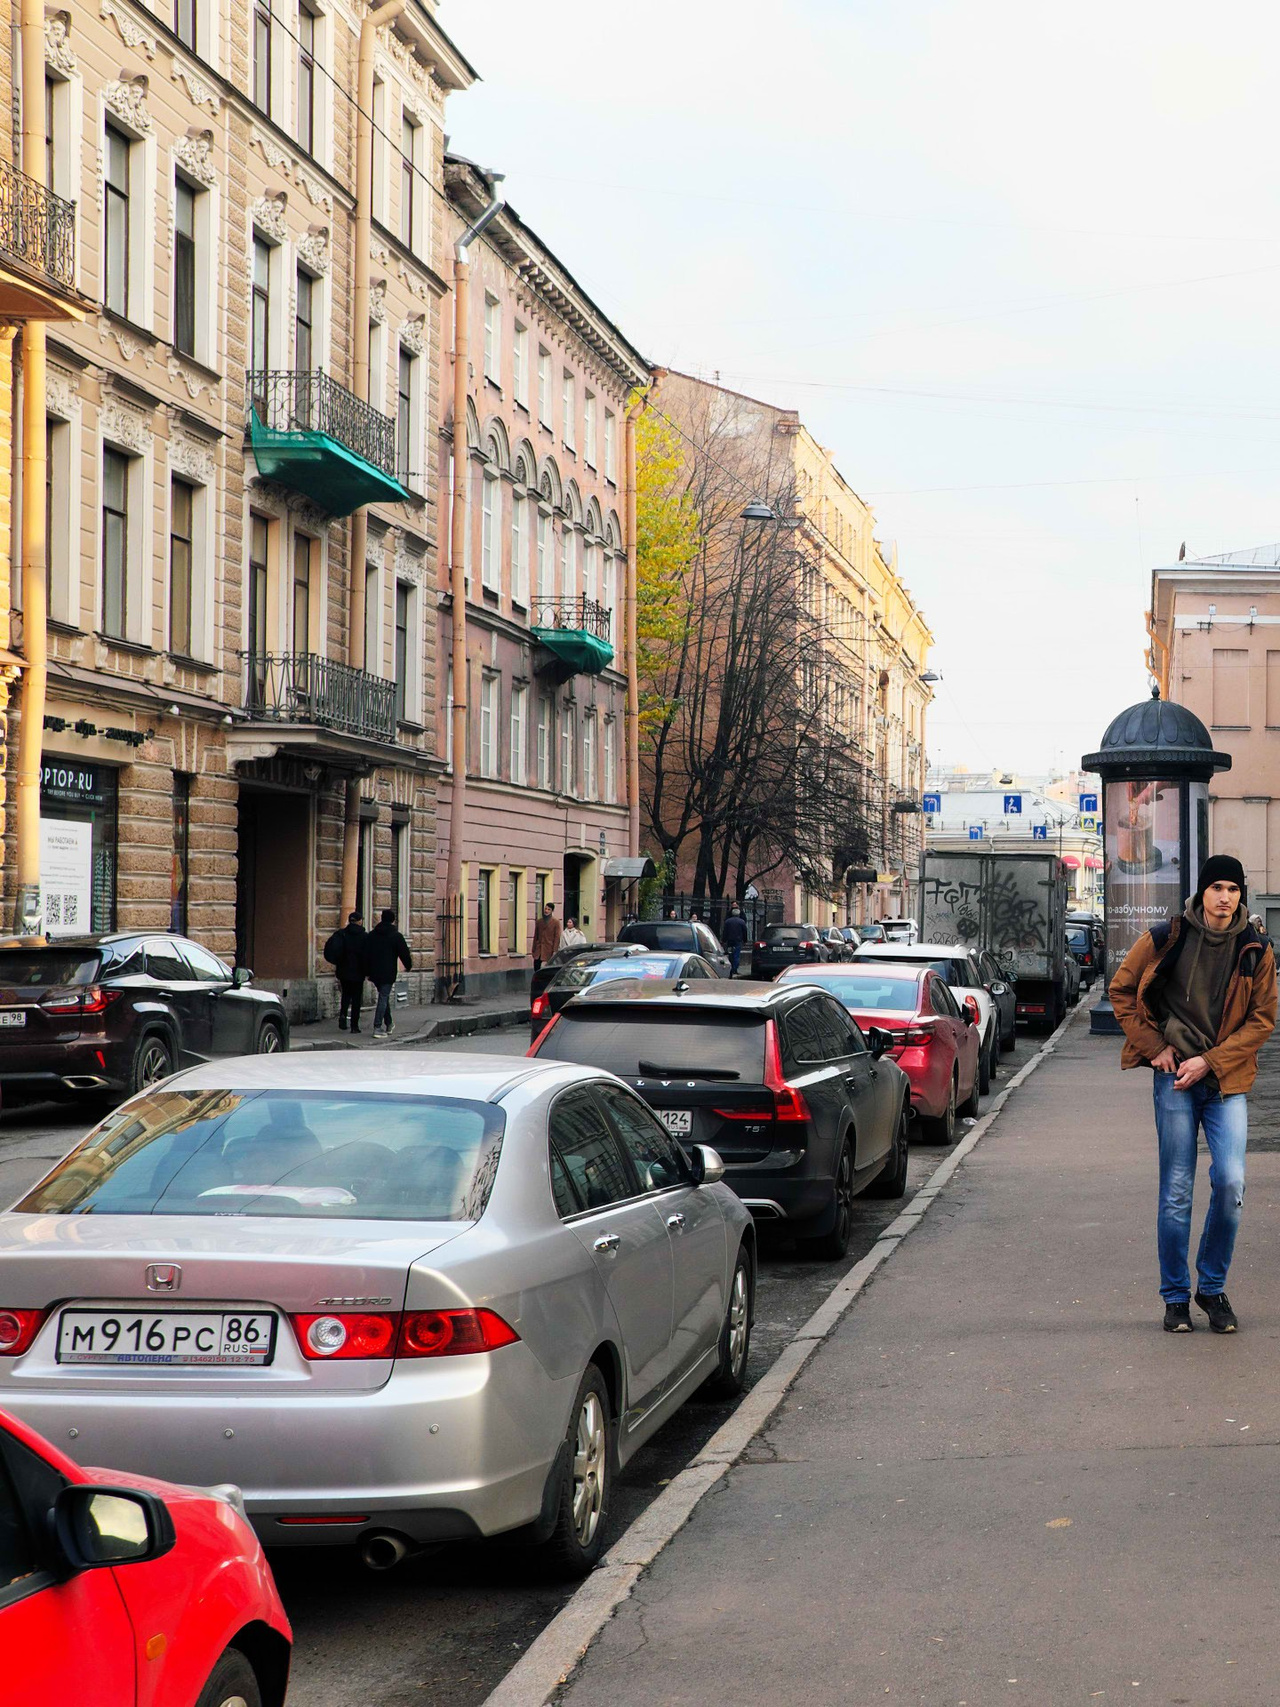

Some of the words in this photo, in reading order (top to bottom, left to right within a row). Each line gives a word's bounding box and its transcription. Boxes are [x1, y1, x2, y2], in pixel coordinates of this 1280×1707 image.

[11, 1013, 22, 1021] 98
[662, 1112, 689, 1126] 124
[70, 1318, 215, 1352] М916РС
[225, 1317, 261, 1344] 86
[223, 1343, 249, 1353] RUS
